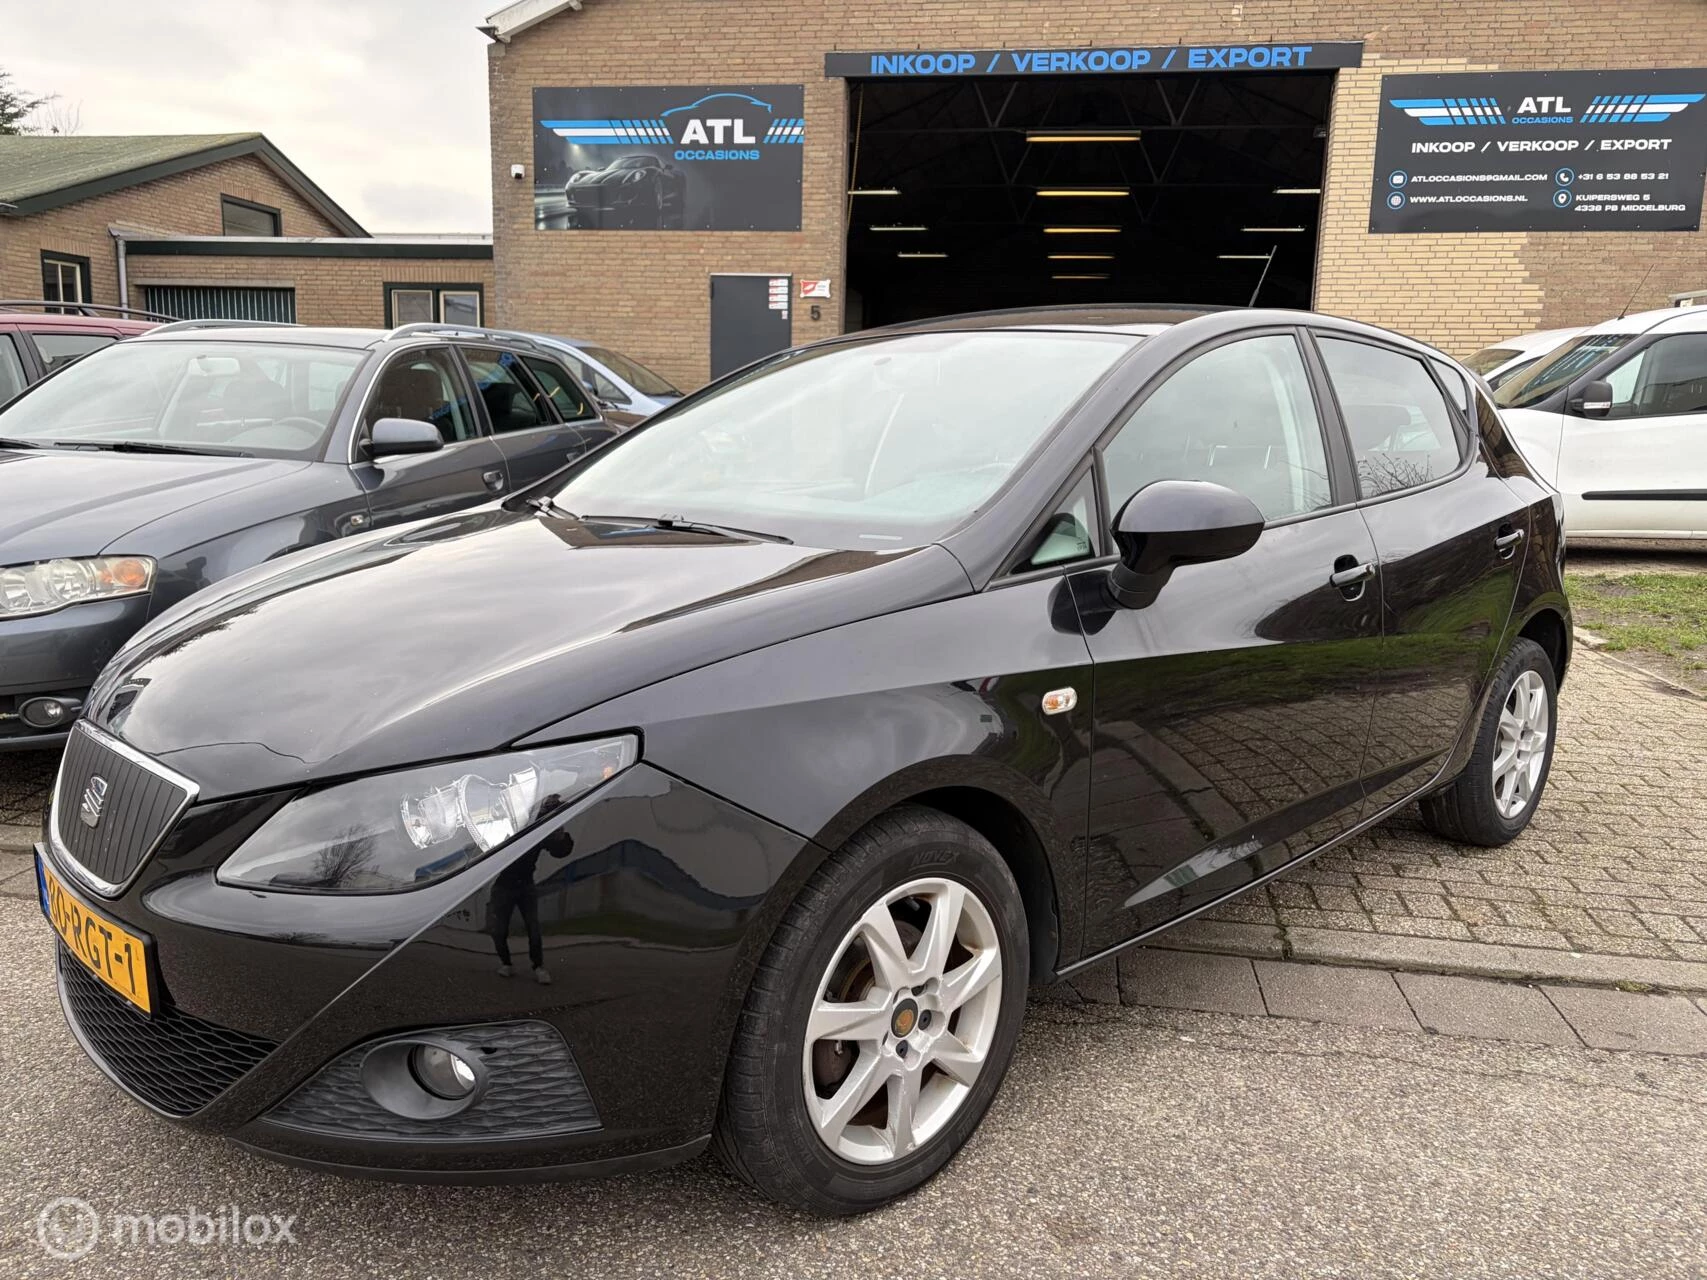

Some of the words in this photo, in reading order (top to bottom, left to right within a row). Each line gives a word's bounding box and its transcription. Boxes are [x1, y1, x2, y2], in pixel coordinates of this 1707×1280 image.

[870, 53, 976, 74] INKOOP
[985, 53, 1001, 73] /
[1011, 50, 1151, 72] VERKOOP
[1161, 49, 1177, 69] /
[1188, 46, 1313, 69] EXPORT
[1516, 96, 1571, 114] ATL
[1511, 116, 1574, 125] OCCASIONS
[680, 118, 756, 144] ATL
[1411, 141, 1476, 154] INKOOP
[1480, 141, 1491, 154] /
[1497, 140, 1579, 152] VERKOOP
[1584, 140, 1595, 151] /
[1600, 138, 1672, 150] EXPORT
[674, 149, 760, 161] OCCASIONS
[1657, 172, 1670, 180] 21
[1410, 195, 1528, 203] WWW.ATLOCCASIONS.NL
[1620, 204, 1686, 212] MIDDELBURG
[811, 304, 821, 321] 5
